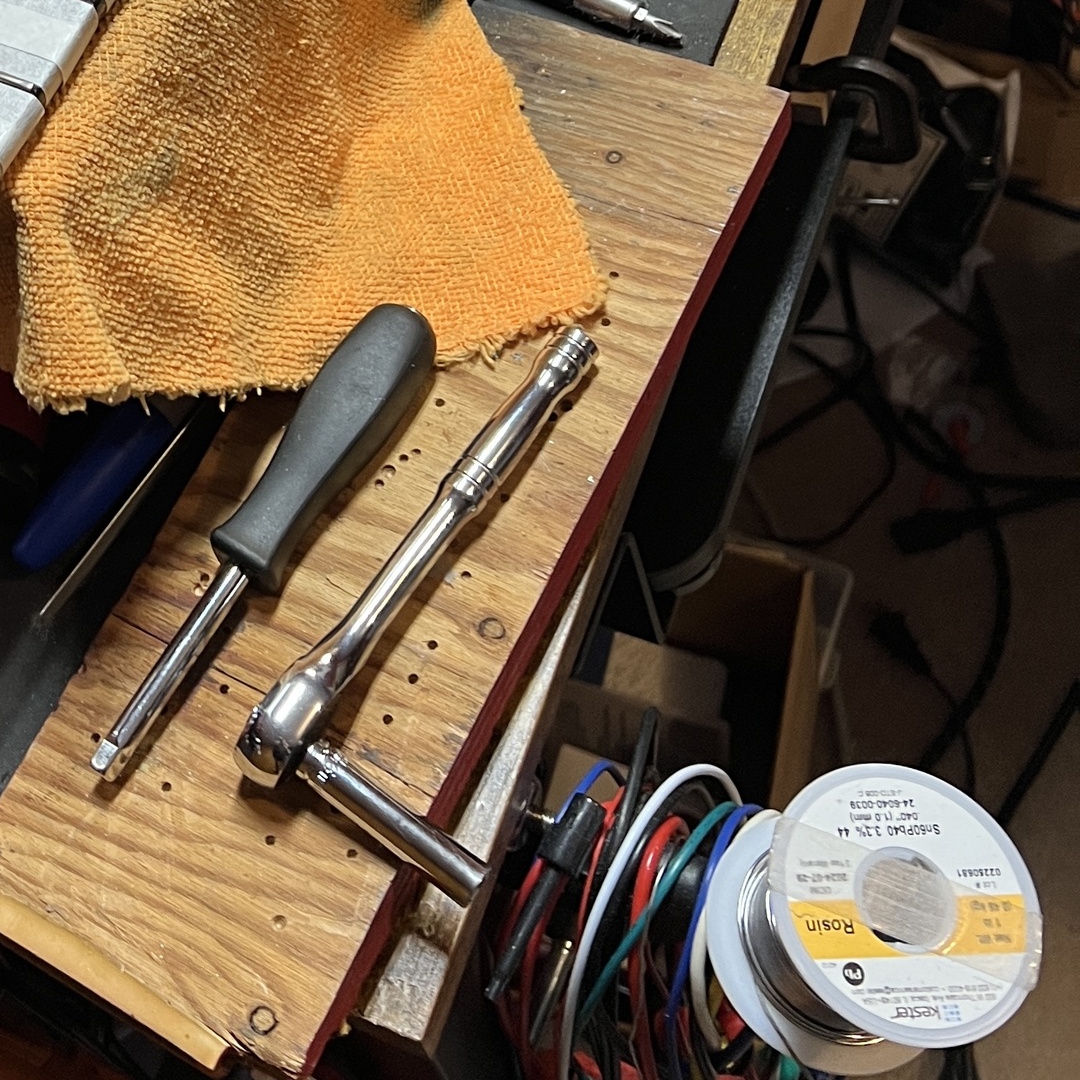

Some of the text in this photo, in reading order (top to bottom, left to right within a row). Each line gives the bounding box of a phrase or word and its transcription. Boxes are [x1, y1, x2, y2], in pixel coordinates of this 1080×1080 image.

[850, 799, 914, 808] 24-6040-0039
[837, 823, 940, 837] Sn60Pb40 3.3% 44
[806, 919, 854, 933] Rosin
[846, 968, 861, 980] Pb
[891, 1006, 940, 1019] kester
